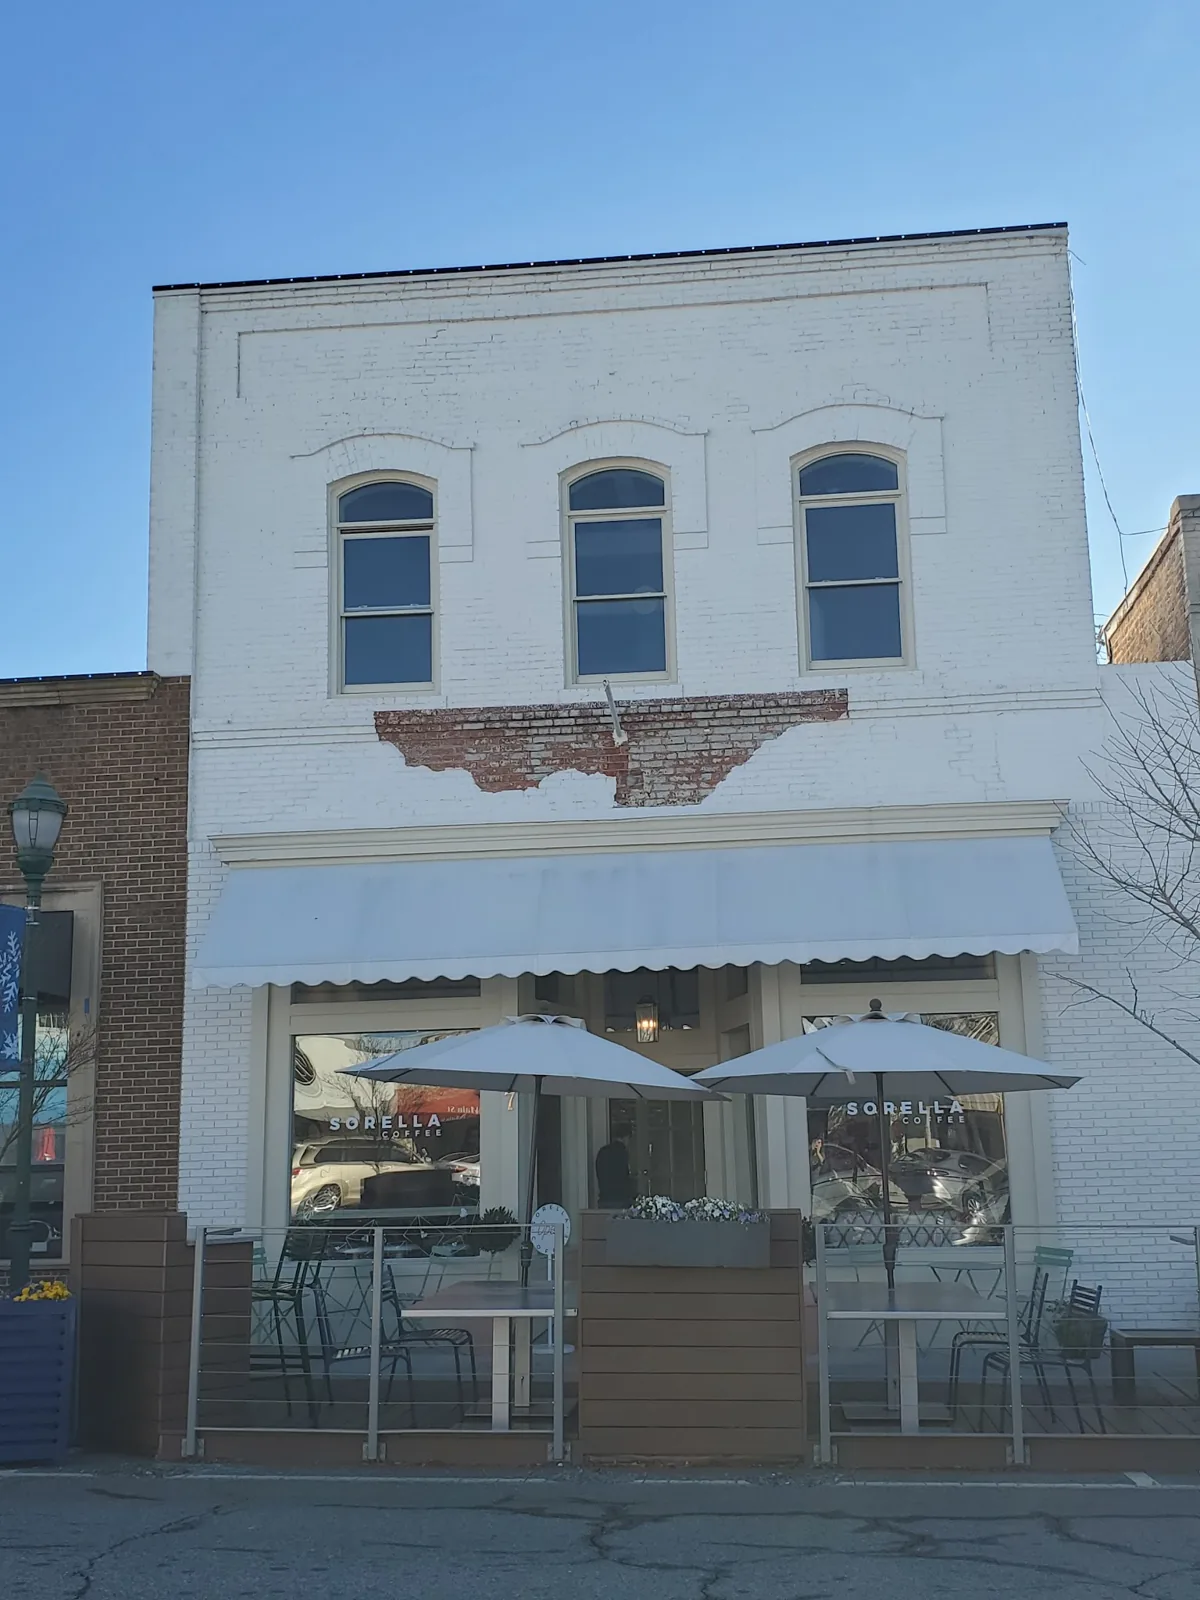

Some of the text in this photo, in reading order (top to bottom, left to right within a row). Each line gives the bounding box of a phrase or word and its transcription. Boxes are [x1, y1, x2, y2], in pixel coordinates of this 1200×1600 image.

[847, 1100, 964, 1115] SORELLA
[329, 1113, 441, 1130] SORELLA
[902, 1116, 965, 1125] COFFEE
[382, 1129, 442, 1139] COFFEE
[532, 1204, 569, 1224] ORELLA
